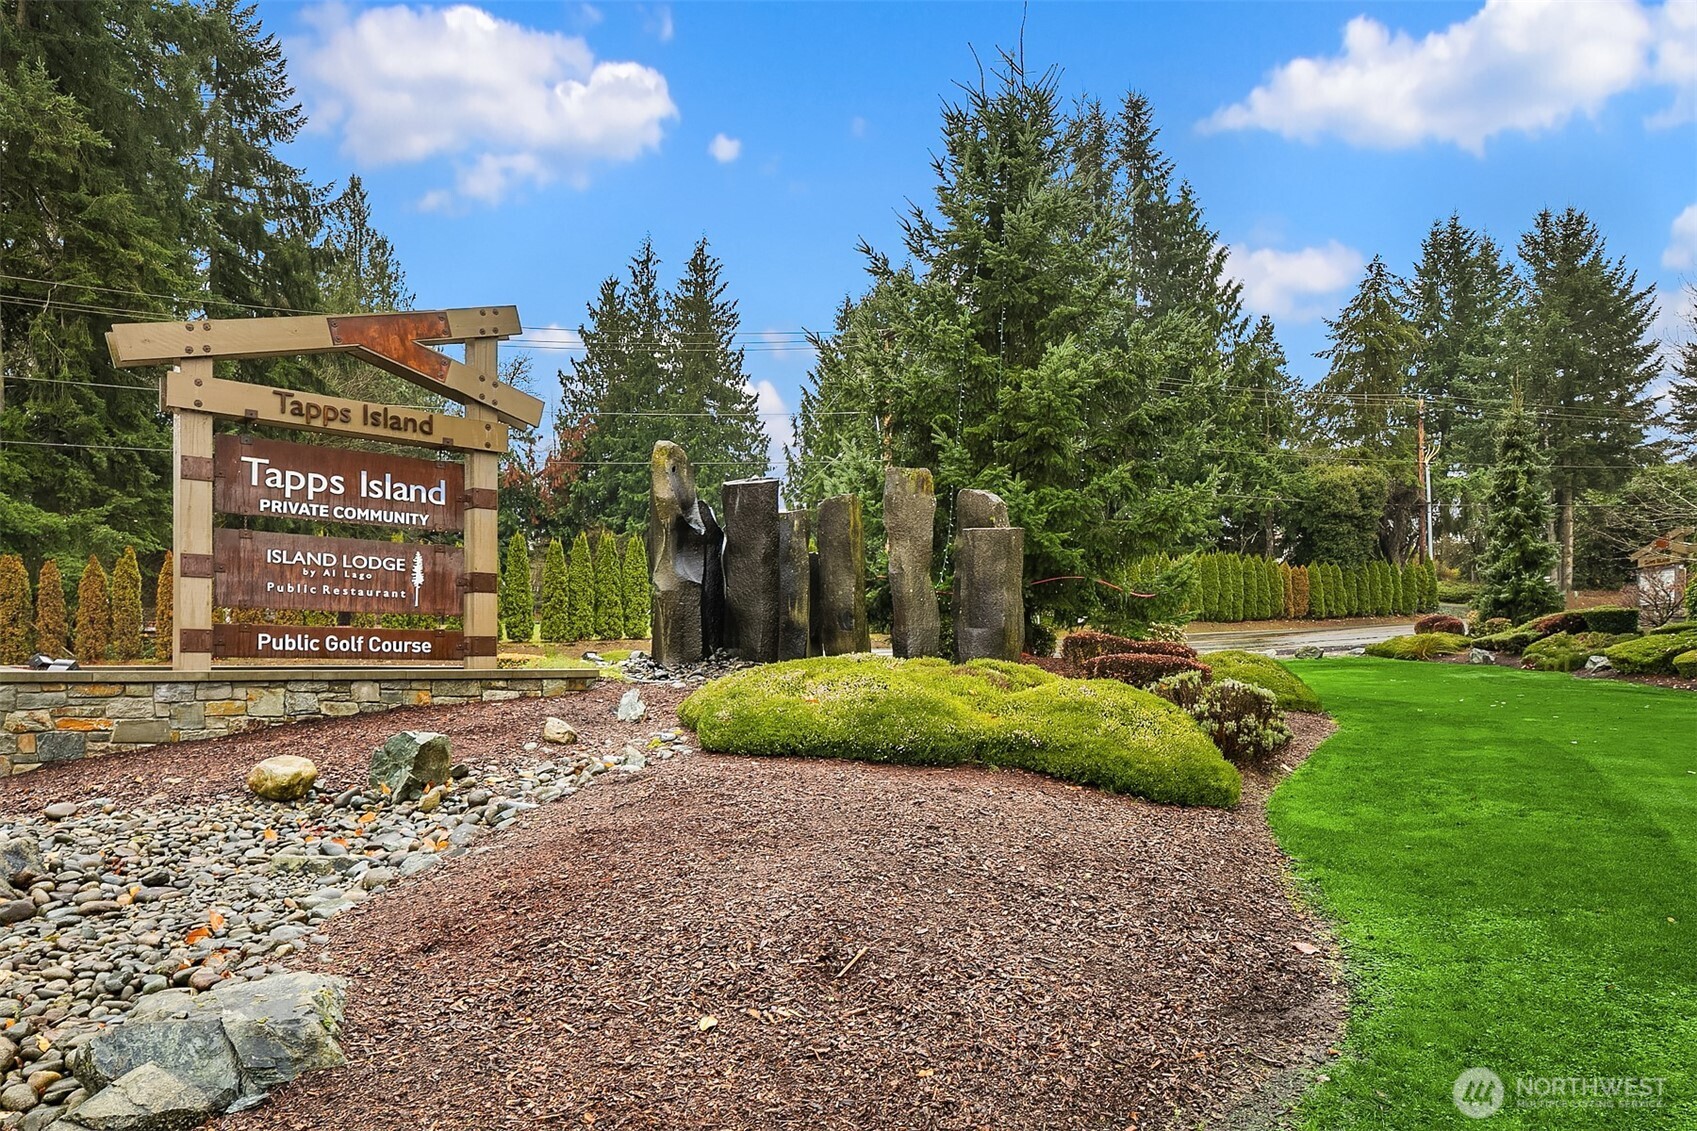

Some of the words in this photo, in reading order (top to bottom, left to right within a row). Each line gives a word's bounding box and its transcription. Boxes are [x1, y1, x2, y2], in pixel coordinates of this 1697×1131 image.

[272, 389, 351, 427] Tapps
[362, 403, 434, 435] Island
[240, 455, 345, 500] Tapps
[360, 470, 446, 506] Island
[259, 499, 329, 517] PRIVATE
[333, 506, 430, 526] COMMUNITY
[266, 549, 337, 567] ISLAND
[342, 554, 406, 571] LODGE
[302, 568, 316, 578] by
[344, 570, 372, 580] Lago
[266, 582, 317, 594] Public
[322, 585, 407, 598] Restaurant
[257, 633, 320, 651] Public
[325, 635, 364, 652] Golf
[368, 636, 432, 654] Course
